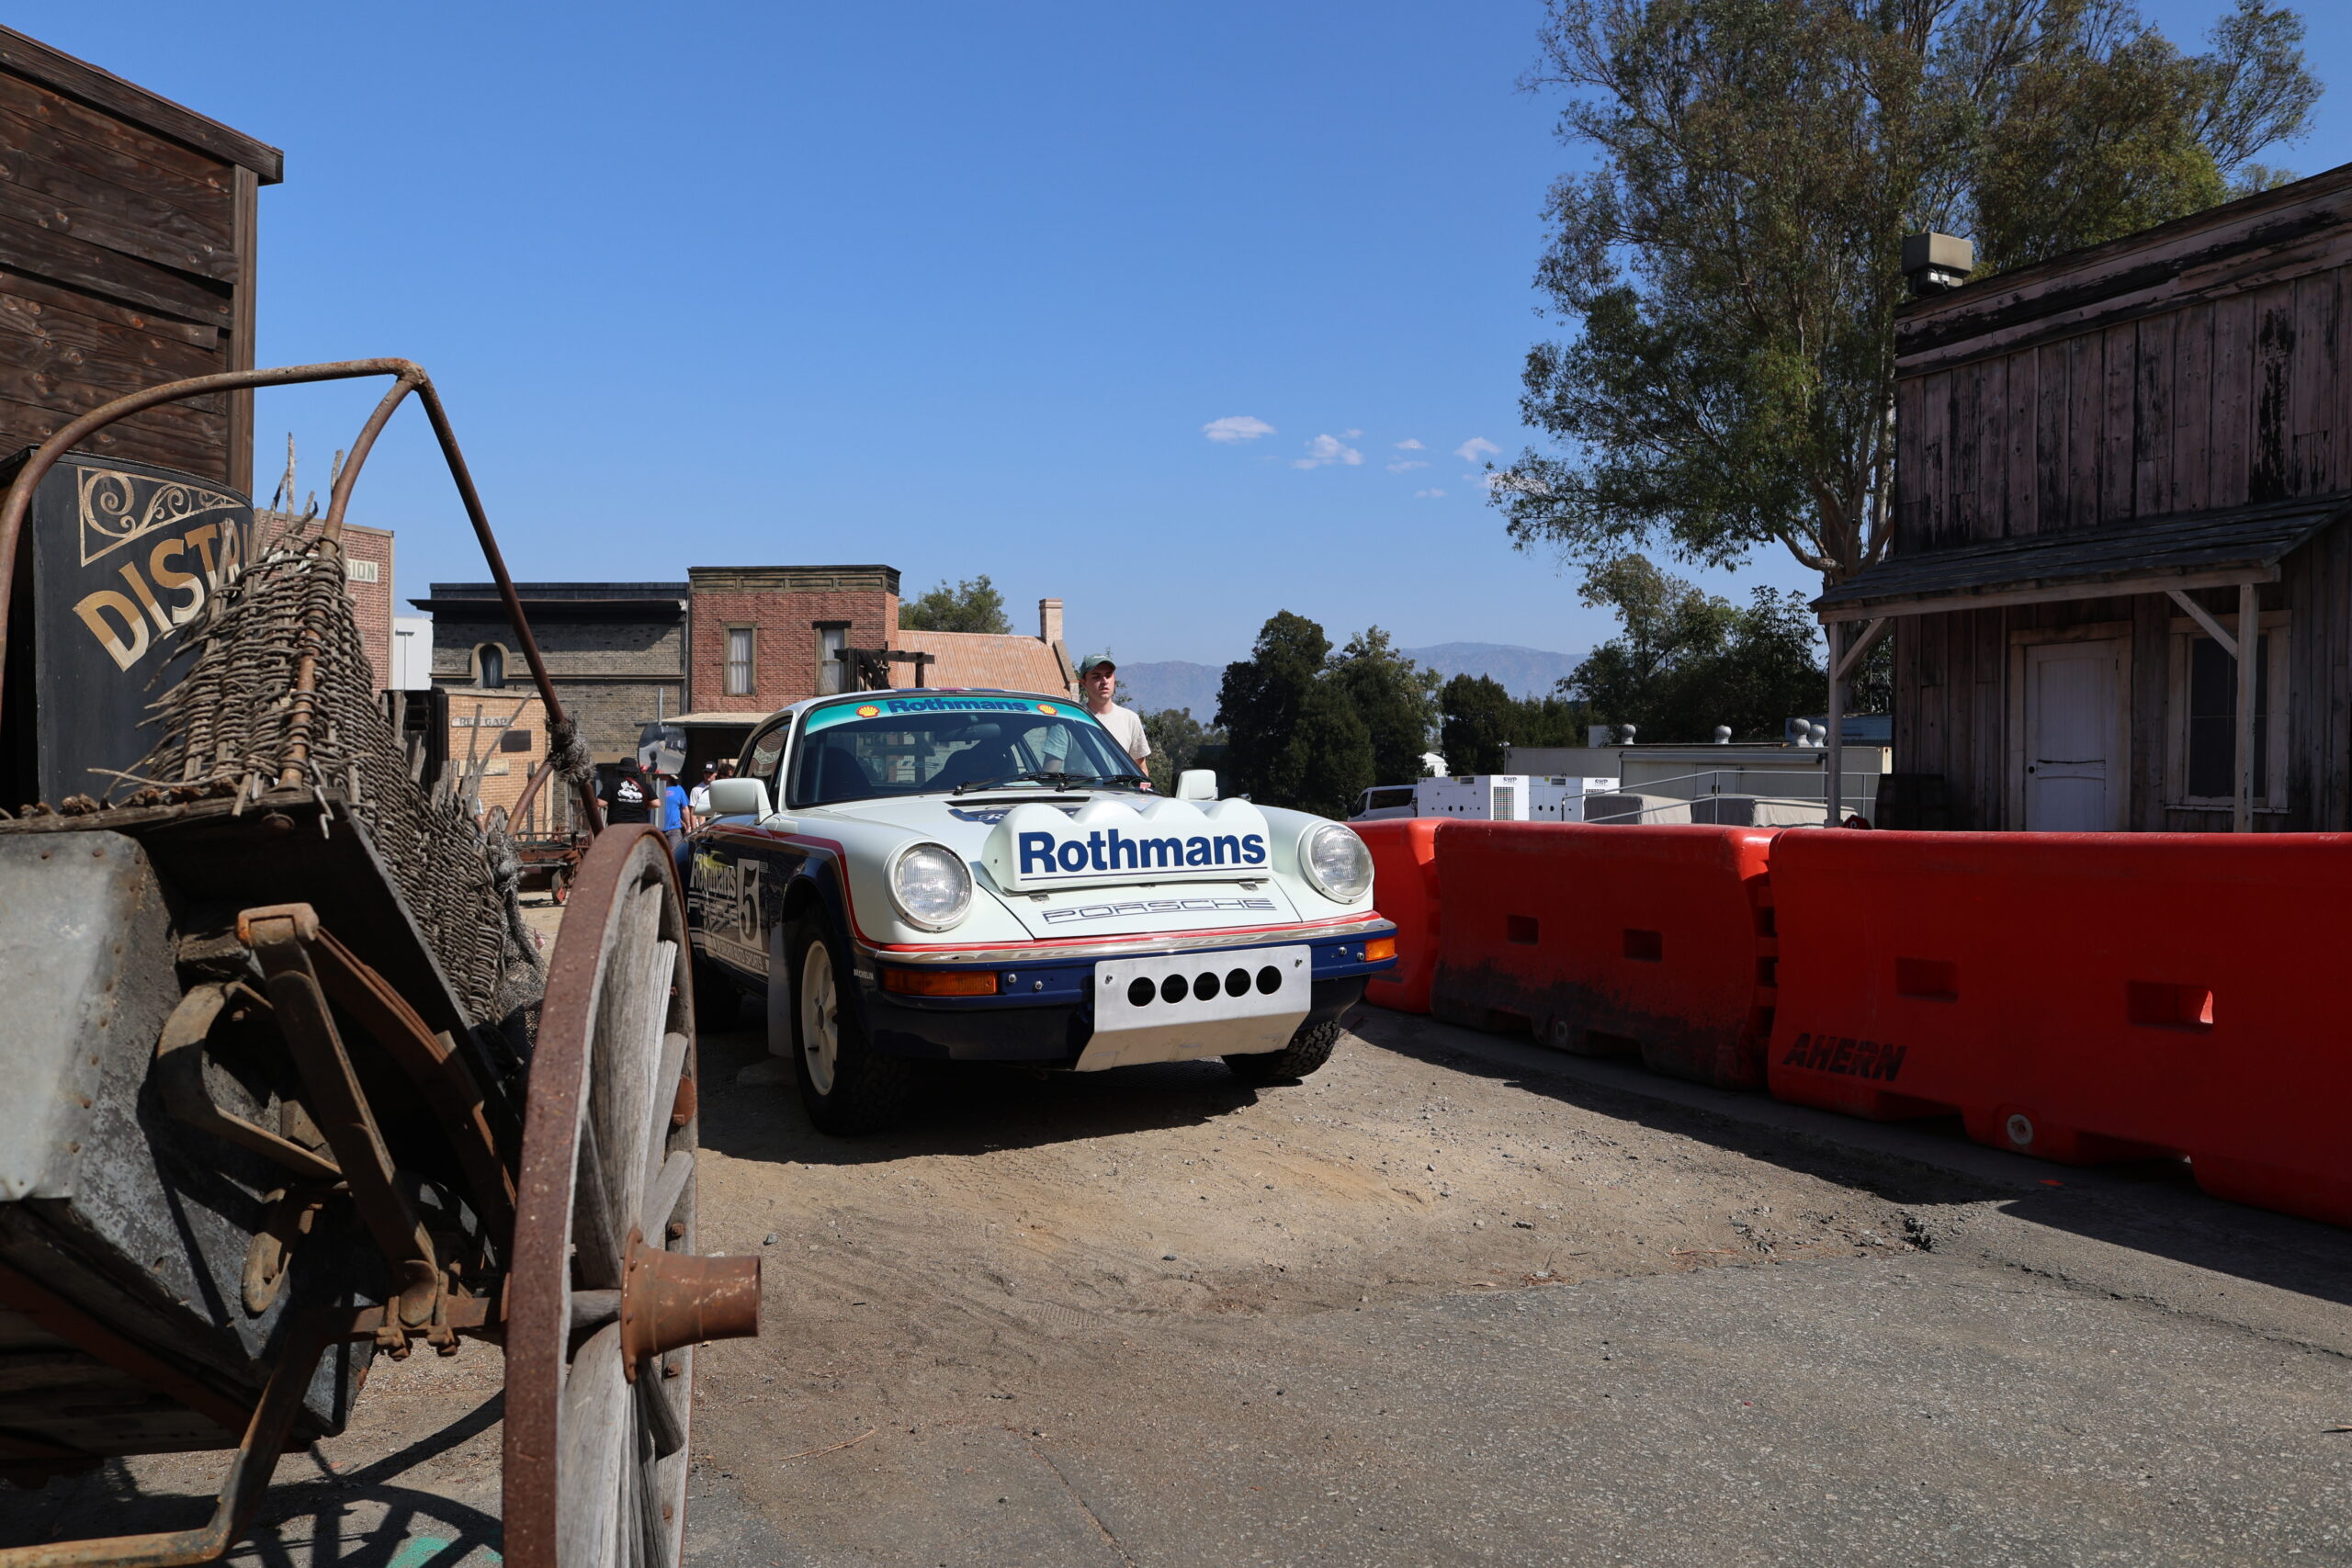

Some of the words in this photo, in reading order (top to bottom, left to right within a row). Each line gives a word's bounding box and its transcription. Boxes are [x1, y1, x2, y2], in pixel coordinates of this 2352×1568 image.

[887, 698, 1030, 713] Rothmans
[1019, 829, 1266, 874] Rothmans
[741, 865, 758, 942] 5
[1042, 898, 1277, 924] PORSCHE
[1782, 1032, 1907, 1082] AHERN
